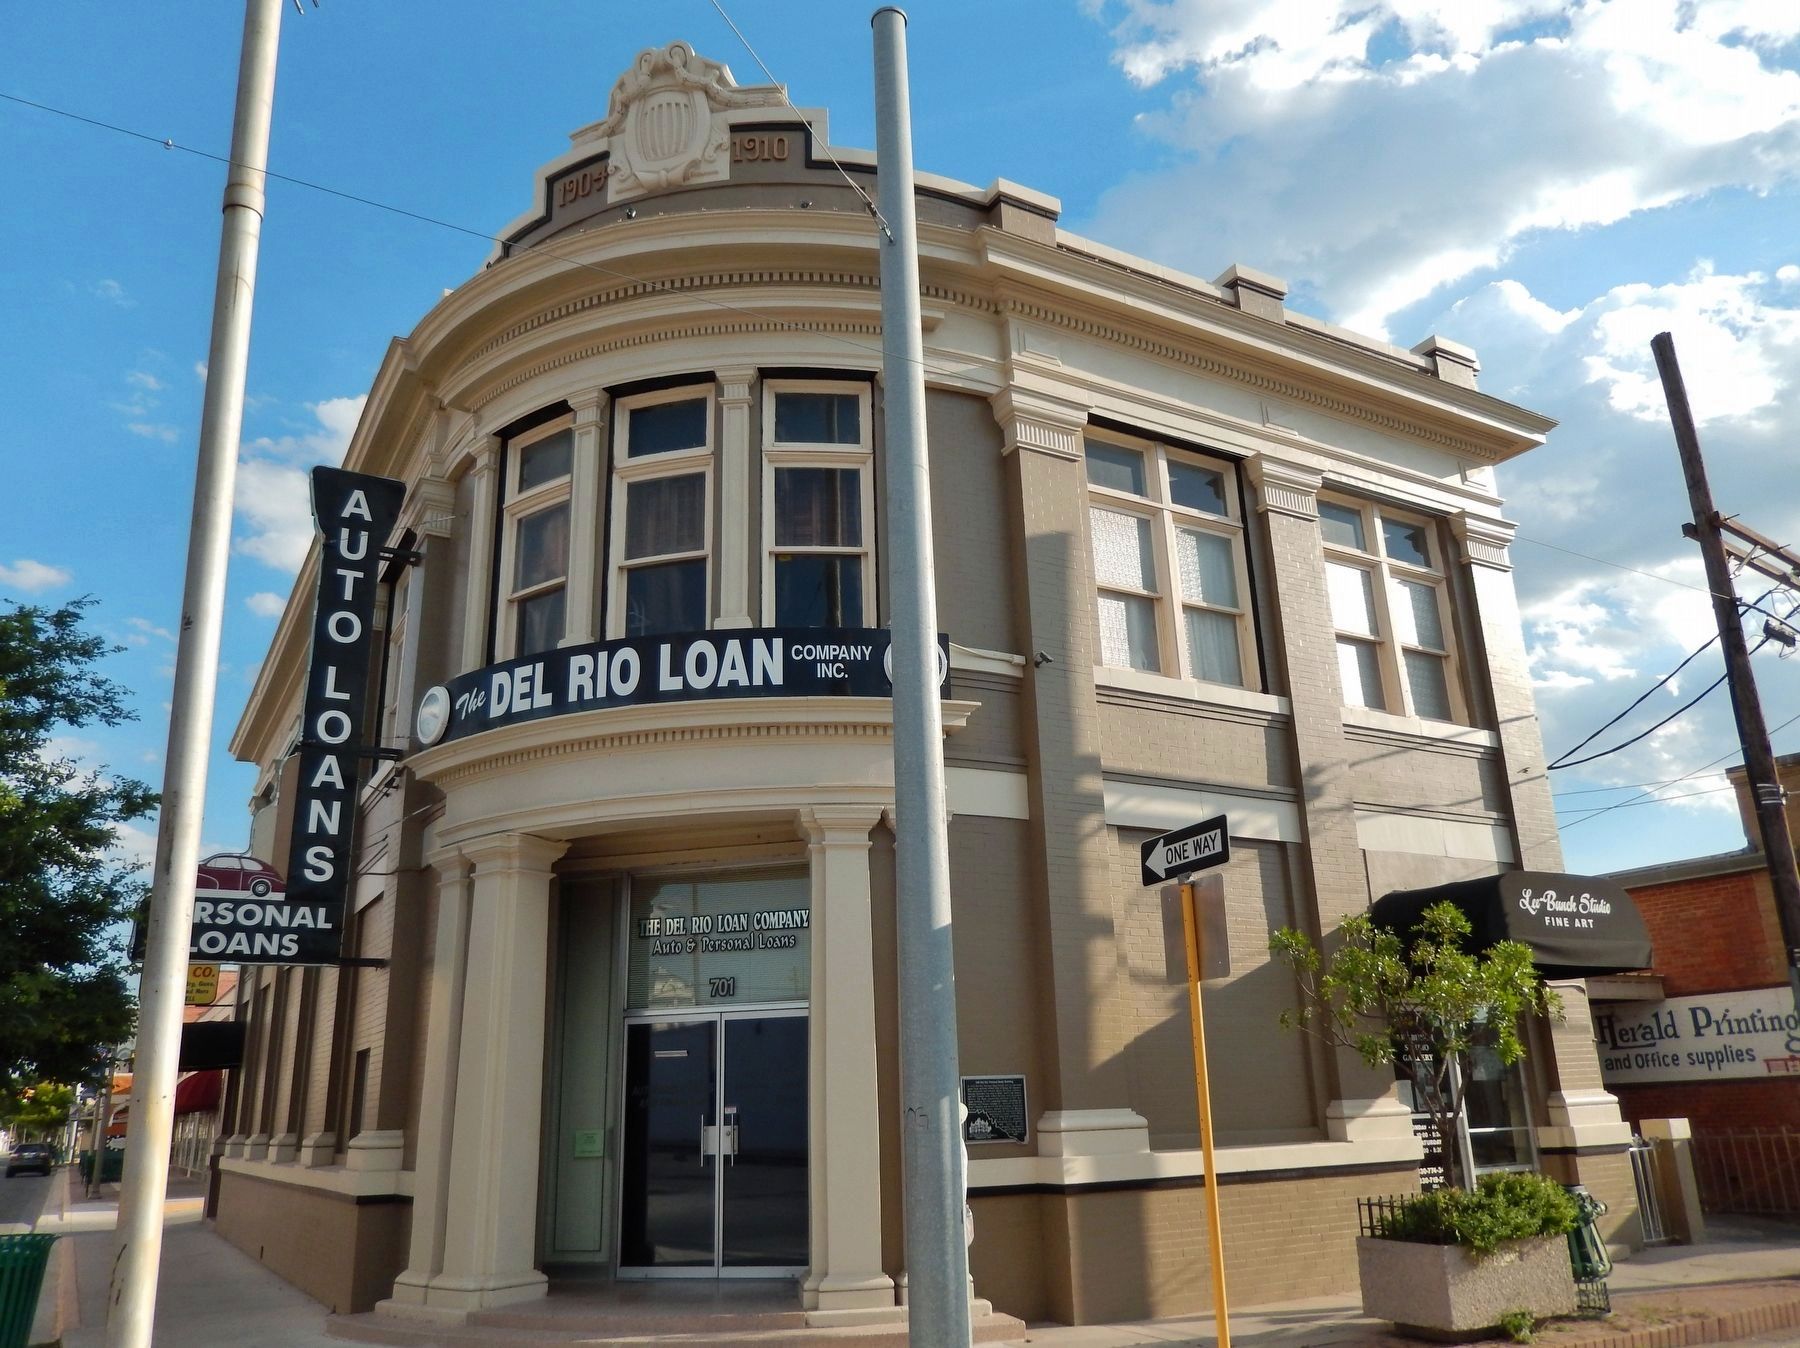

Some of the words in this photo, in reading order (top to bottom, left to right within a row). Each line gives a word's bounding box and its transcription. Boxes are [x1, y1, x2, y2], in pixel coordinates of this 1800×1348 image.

[732, 136, 789, 162] 1910
[328, 490, 372, 644] AUTO
[791, 645, 872, 661] COMPANY
[456, 687, 487, 720] The
[489, 662, 552, 718] DEL
[568, 647, 640, 702] RIO
[659, 638, 783, 691] LOAN
[817, 663, 848, 678] INC.
[304, 665, 352, 882] LOANS
[1166, 843, 1190, 865] ONE
[1193, 833, 1218, 856] WAY
[192, 901, 333, 929] RSONAL
[1579, 893, 1611, 914] Studio
[639, 918, 661, 937] THE
[665, 917, 687, 936] DEL
[691, 915, 712, 934] RIO
[717, 913, 748, 933] LOAN
[753, 909, 809, 930] COMPANY
[1545, 916, 1570, 927] FINE
[1575, 918, 1594, 928] ART
[652, 939, 682, 956] Auto
[686, 938, 696, 953] &
[701, 933, 754, 952] Personal
[758, 933, 796, 949] Loans
[192, 966, 215, 978] CO.
[709, 977, 735, 997] 701
[1596, 1009, 1680, 1050] Herald
[1605, 1052, 1632, 1071] and
[1687, 1044, 1756, 1071] supplies
